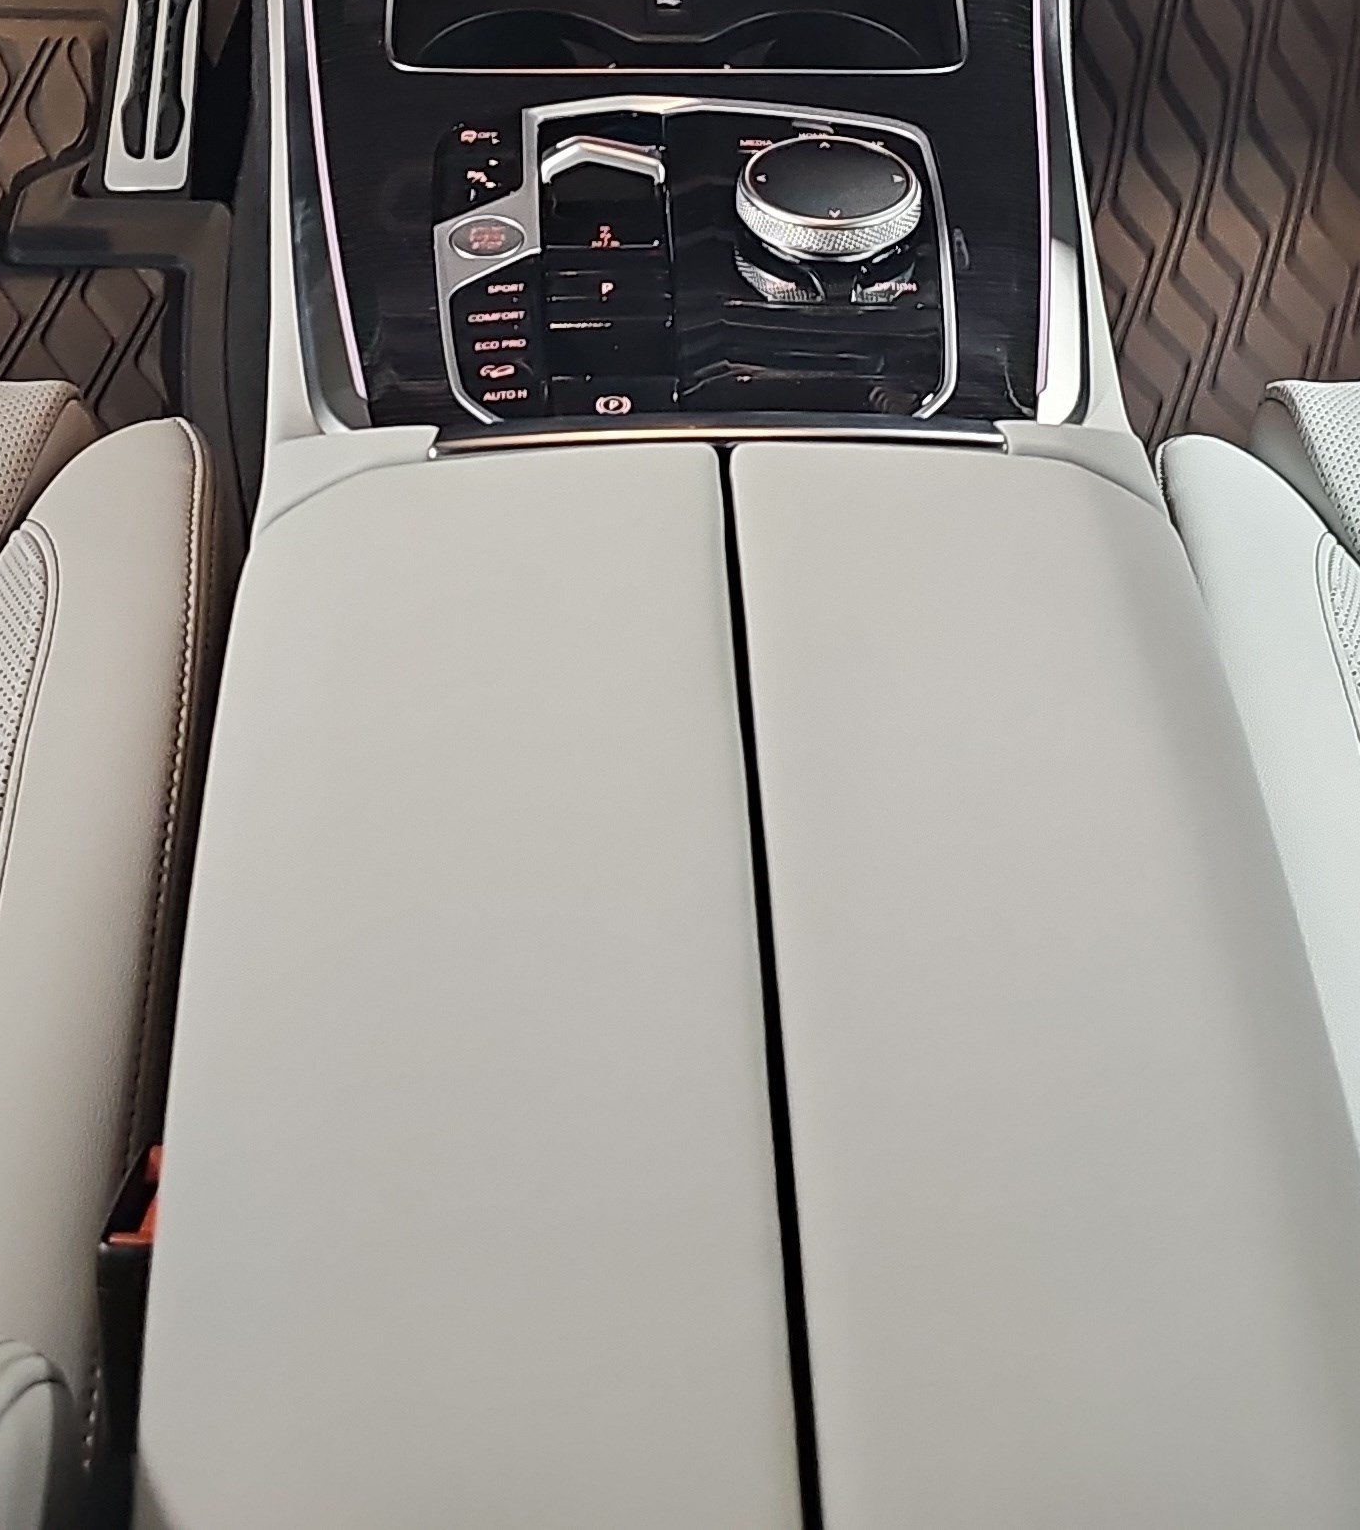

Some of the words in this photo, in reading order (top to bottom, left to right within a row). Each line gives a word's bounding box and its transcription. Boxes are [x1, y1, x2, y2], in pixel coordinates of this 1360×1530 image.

[487, 282, 525, 294] SPORT
[601, 281, 614, 295] P
[467, 310, 526, 323] COMFORT
[474, 339, 500, 352] ECO
[501, 338, 527, 350] PRO
[482, 389, 516, 402] AUTO
[516, 388, 528, 400] H
